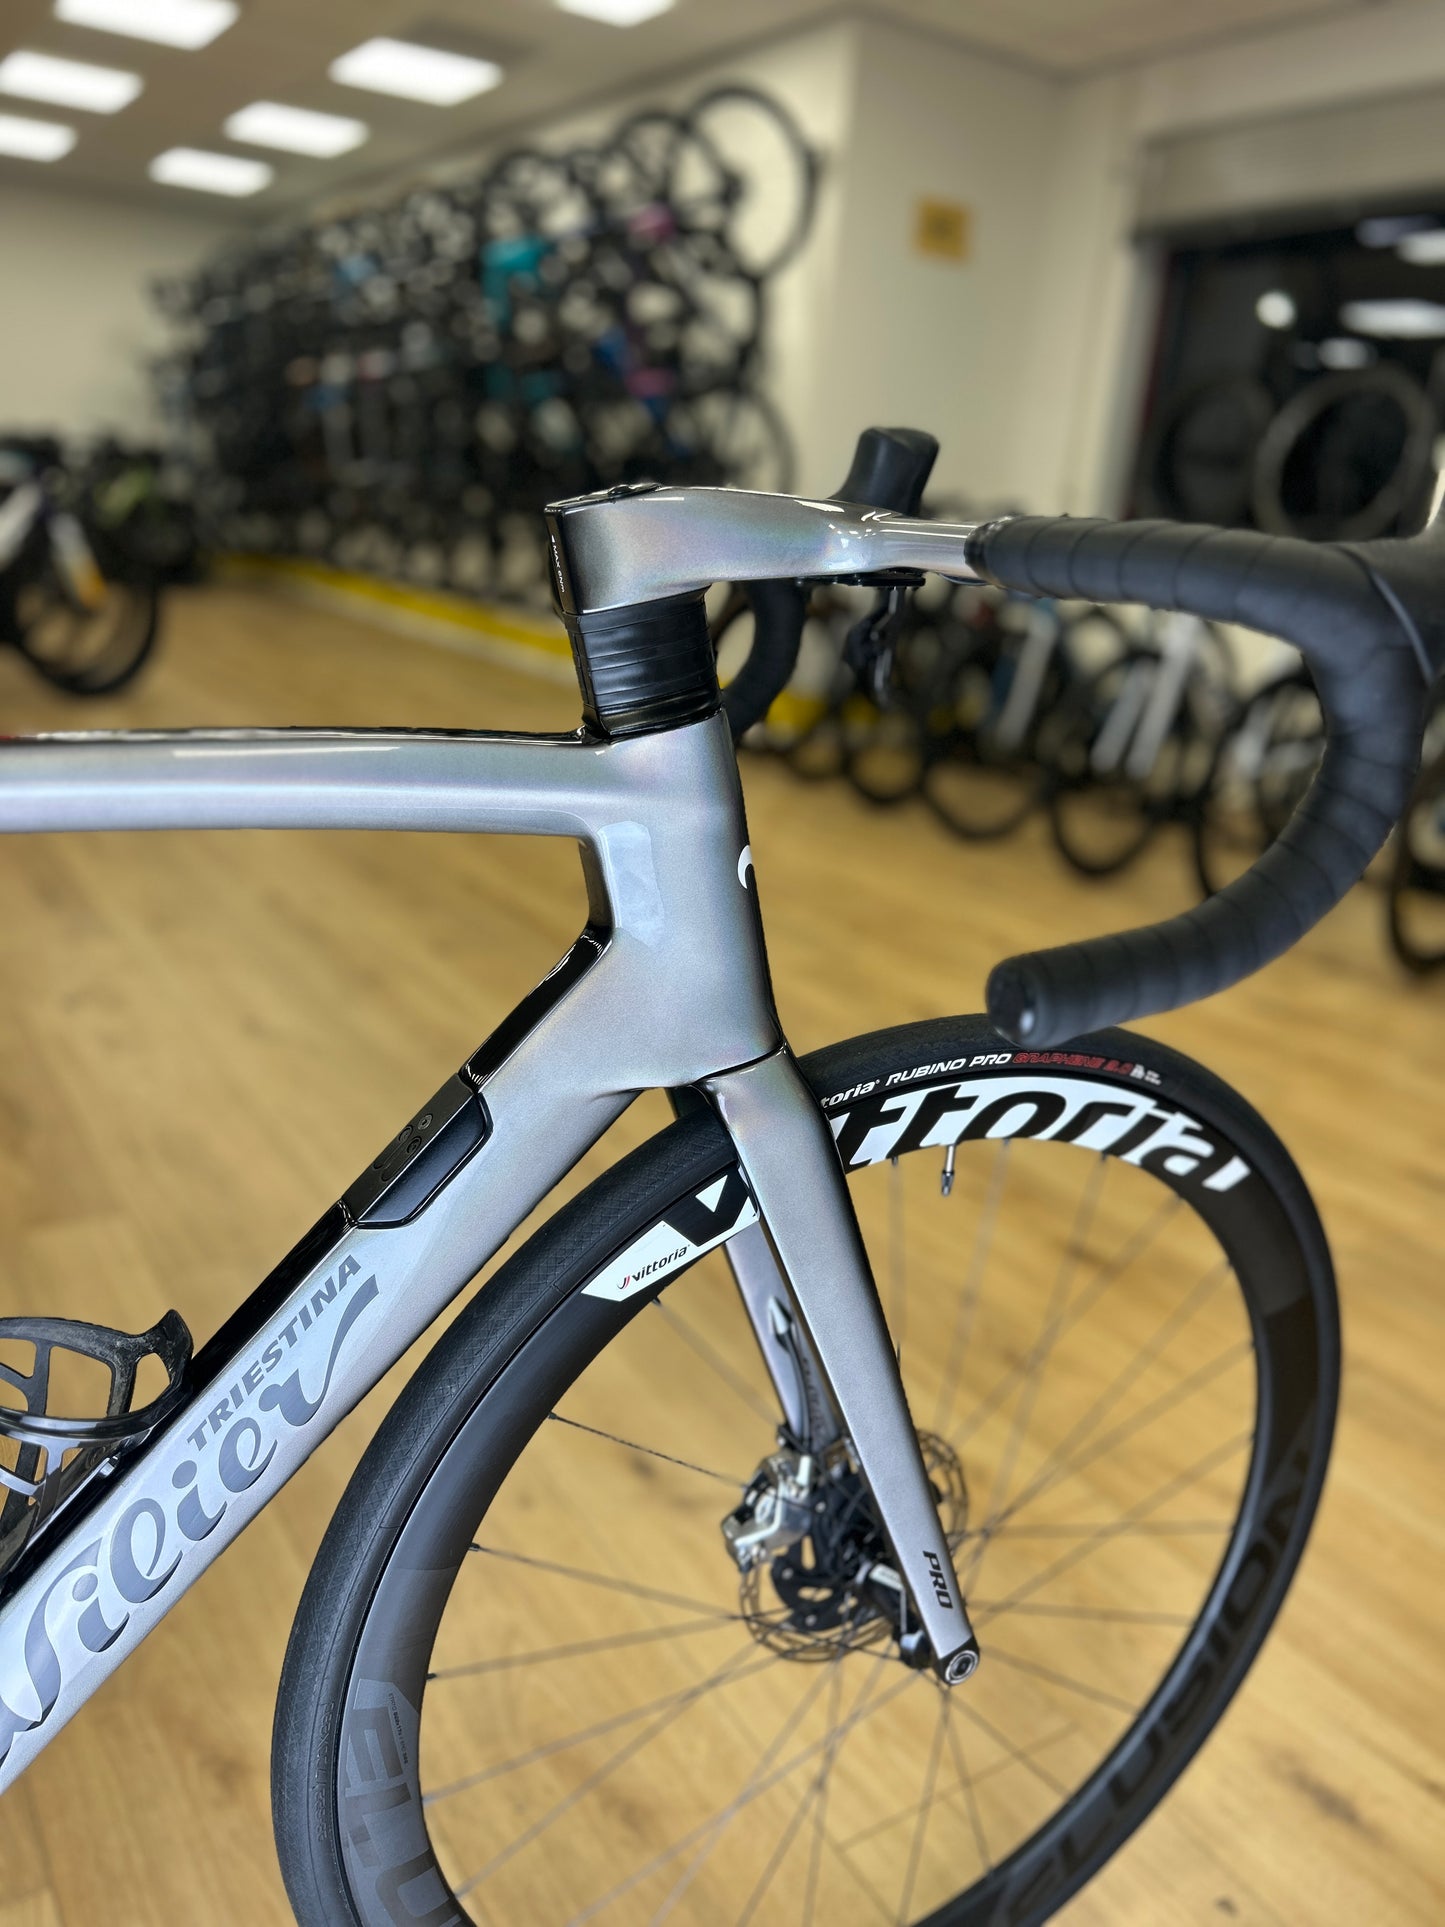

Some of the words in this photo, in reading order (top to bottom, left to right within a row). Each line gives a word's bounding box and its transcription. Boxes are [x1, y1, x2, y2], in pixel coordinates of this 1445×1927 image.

[552, 545, 561, 568] MAX
[820, 1080, 878, 1108] toria
[885, 1058, 967, 1087] RUBINO
[968, 1053, 1012, 1068] PRO
[632, 1245, 688, 1282] vittoria
[187, 1254, 361, 1451] TRIESTINA
[923, 1551, 953, 1609] PRO
